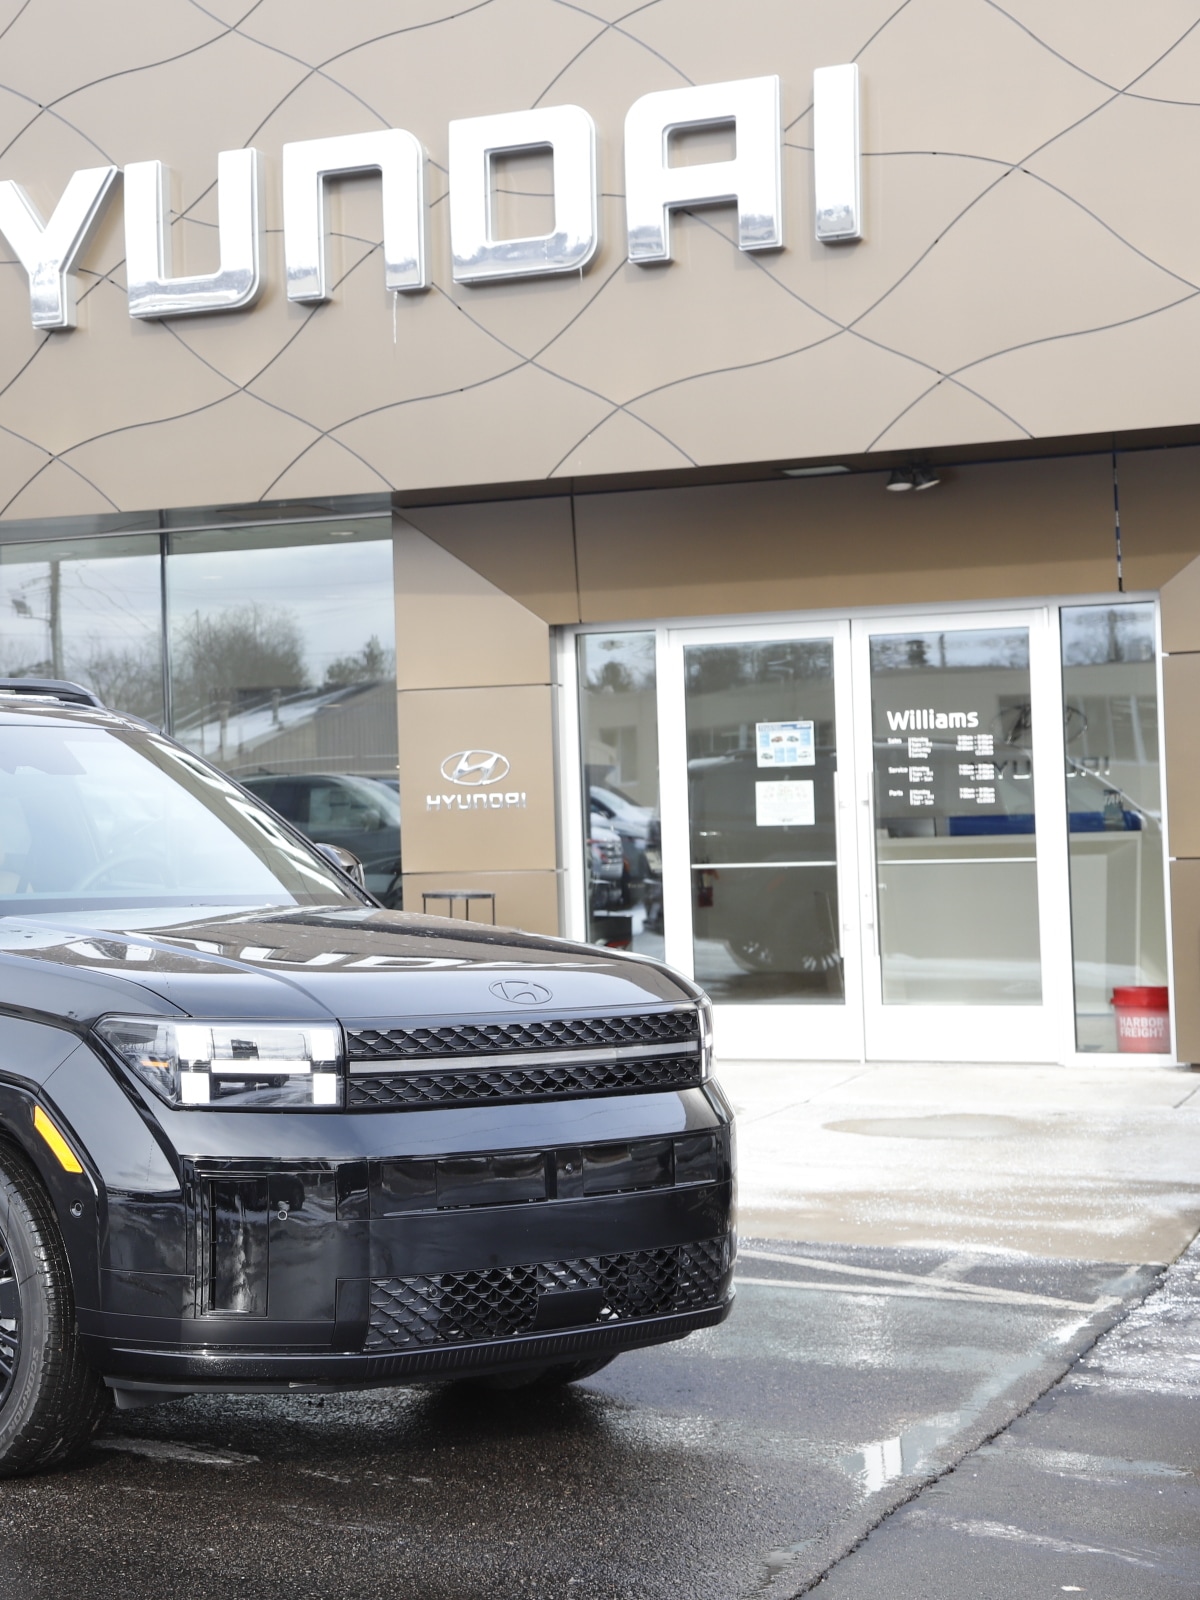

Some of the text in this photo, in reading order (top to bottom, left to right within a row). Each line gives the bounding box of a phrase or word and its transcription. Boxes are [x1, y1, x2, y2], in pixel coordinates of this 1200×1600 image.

[886, 708, 979, 731] Williams
[426, 792, 526, 811] HYUNDAI
[1120, 1016, 1164, 1028] HARBOR
[1121, 1027, 1163, 1038] FREIGHT
[7, 1347, 39, 1435] SCORPION
